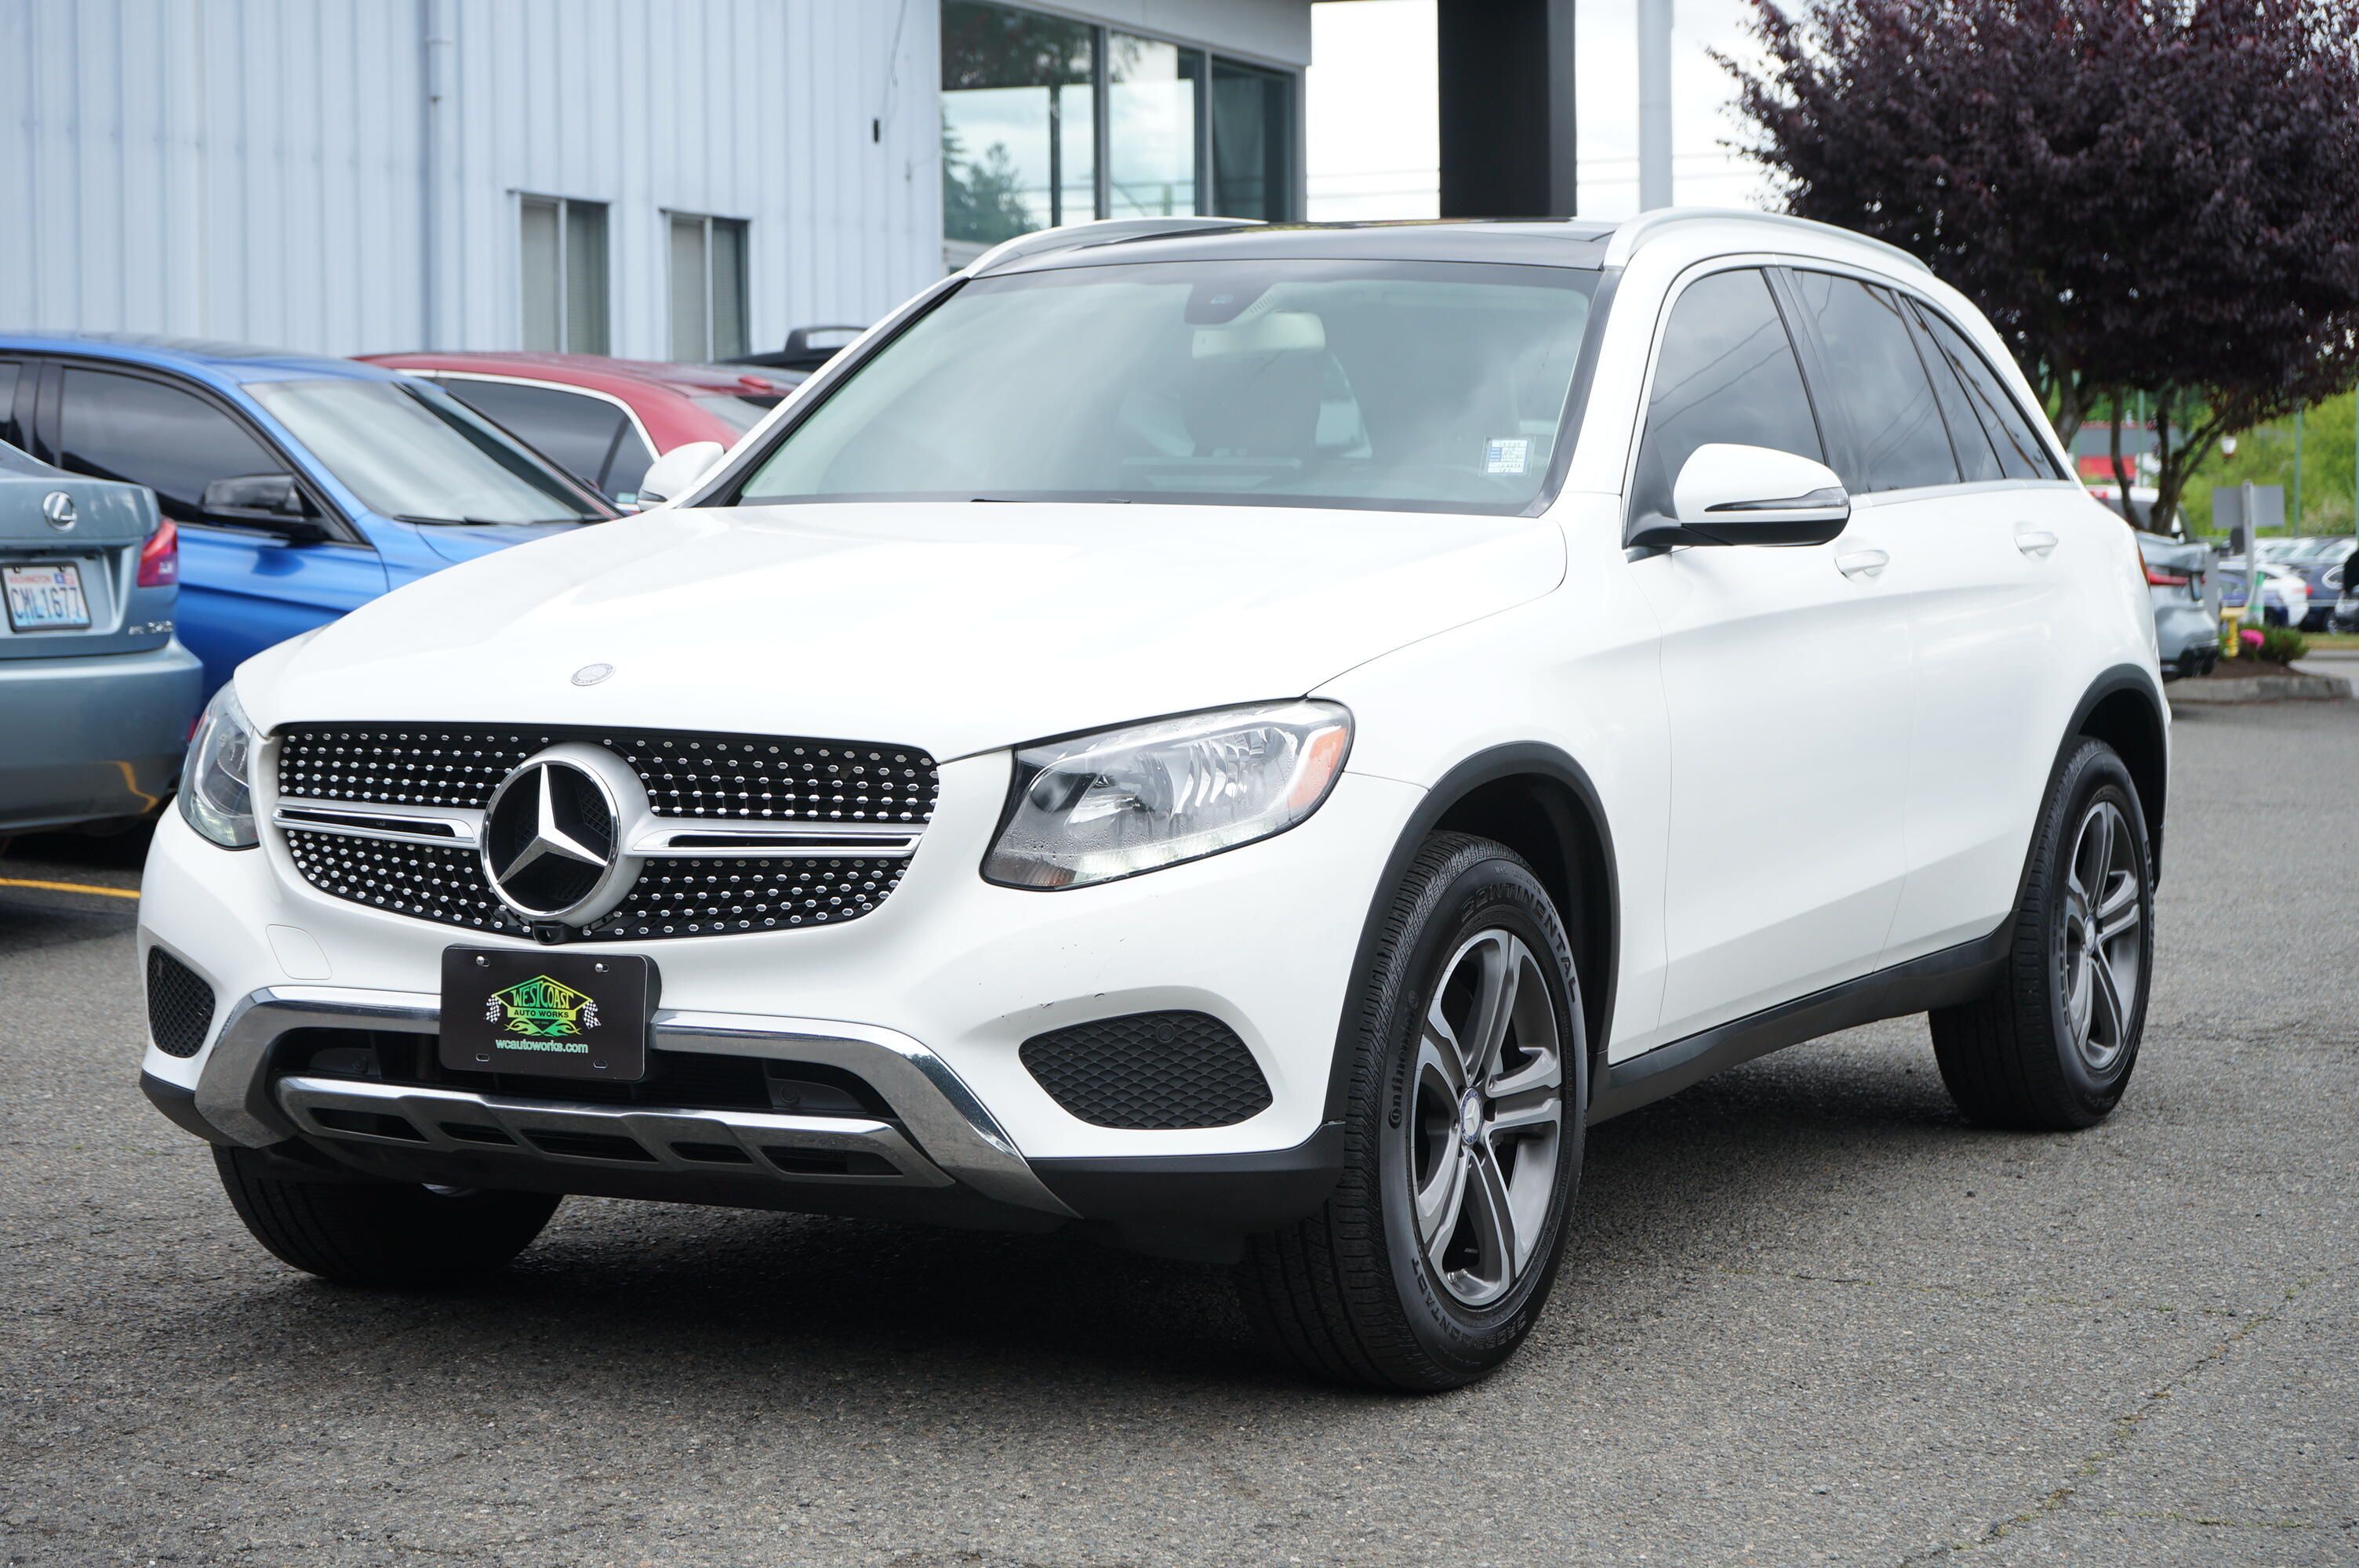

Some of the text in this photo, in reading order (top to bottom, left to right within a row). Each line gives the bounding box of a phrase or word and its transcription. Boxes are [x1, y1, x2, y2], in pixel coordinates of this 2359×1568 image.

[514, 1008, 569, 1018] AUTO WORKS
[496, 1038, 588, 1054] wcautoworks.com
